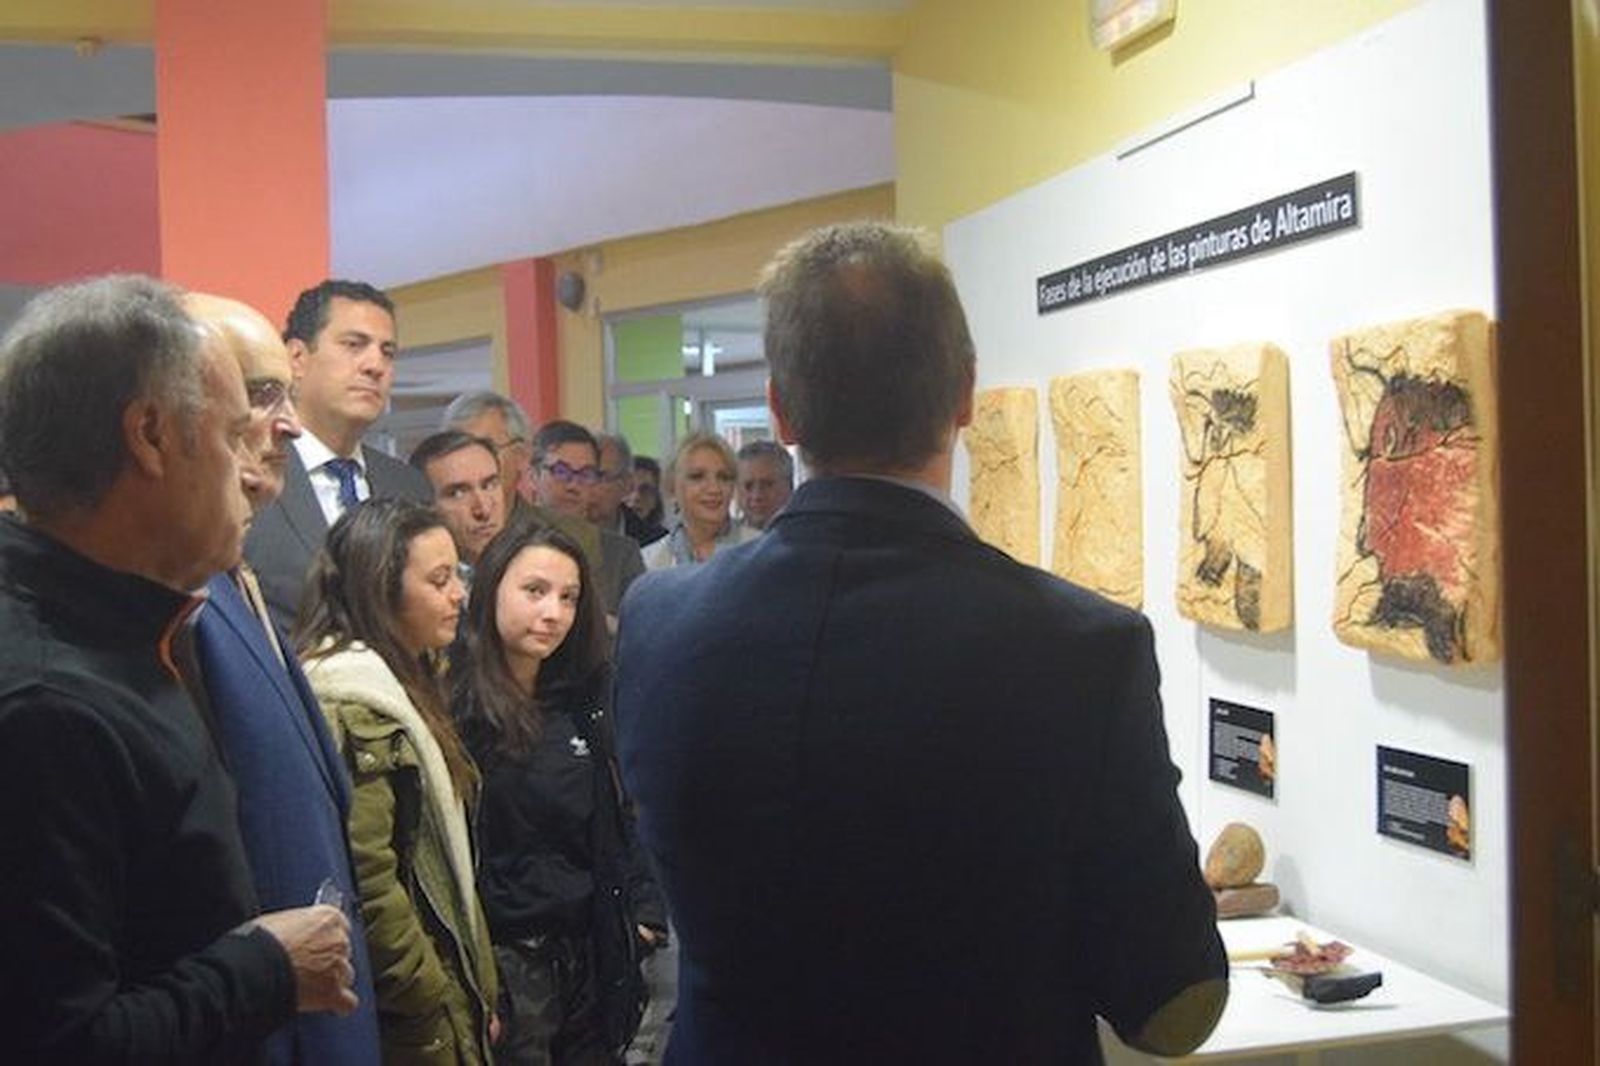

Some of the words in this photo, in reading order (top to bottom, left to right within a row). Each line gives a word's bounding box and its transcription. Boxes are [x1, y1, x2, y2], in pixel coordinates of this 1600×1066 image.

[1040, 282, 1066, 305] Fases
[1068, 272, 1081, 298] de
[1083, 269, 1092, 294] la
[1094, 252, 1148, 295] ejecución
[1150, 246, 1166, 273] de
[1168, 240, 1186, 268] las
[1188, 225, 1249, 275] pinturas
[1251, 213, 1272, 245] de
[1275, 192, 1353, 238] Altamira
